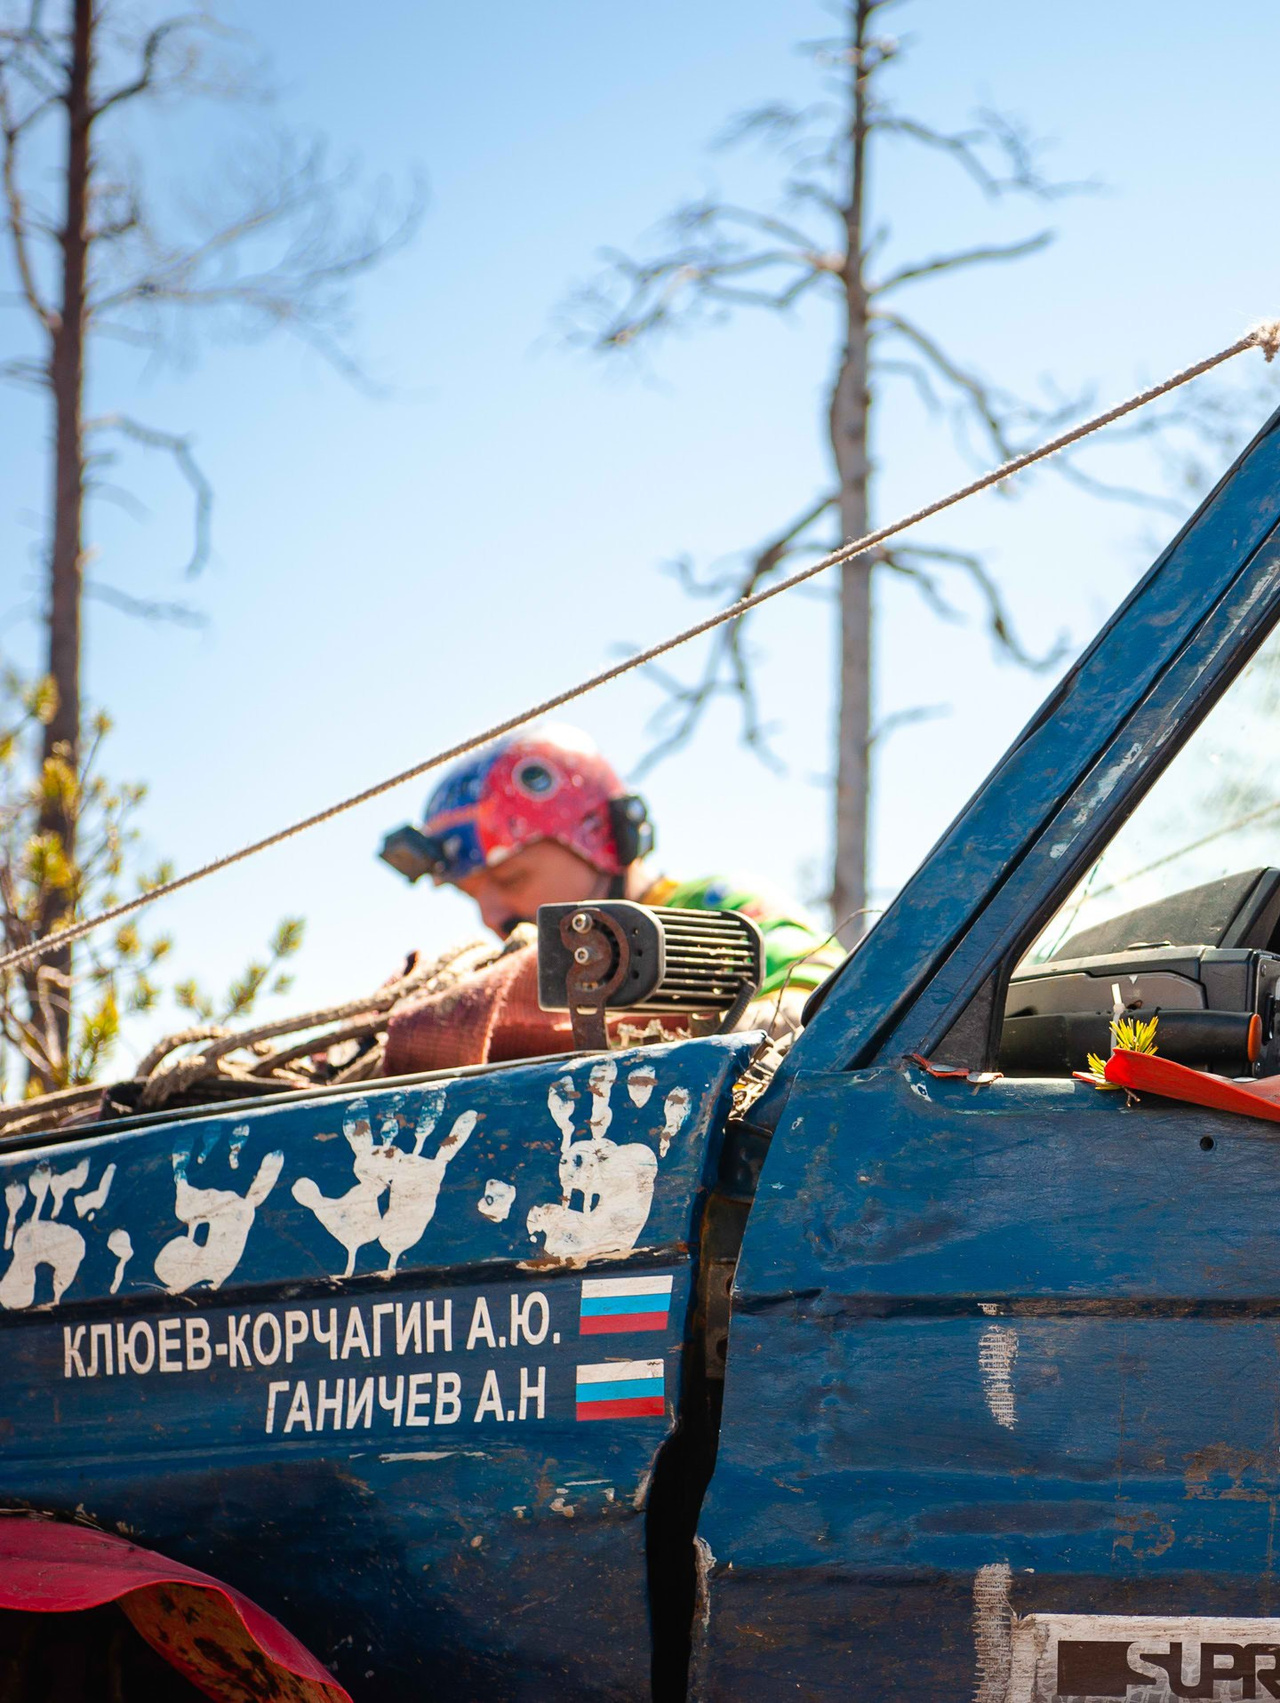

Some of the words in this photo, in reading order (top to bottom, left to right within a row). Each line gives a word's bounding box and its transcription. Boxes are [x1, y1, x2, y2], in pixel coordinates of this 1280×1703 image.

[63, 1300, 453, 1378] КЛЮЕВ-КОРЧАГИН
[467, 1291, 562, 1350] А.Ю.
[265, 1371, 461, 1433] ГАНИЧЕВ
[473, 1366, 547, 1423] А.Н
